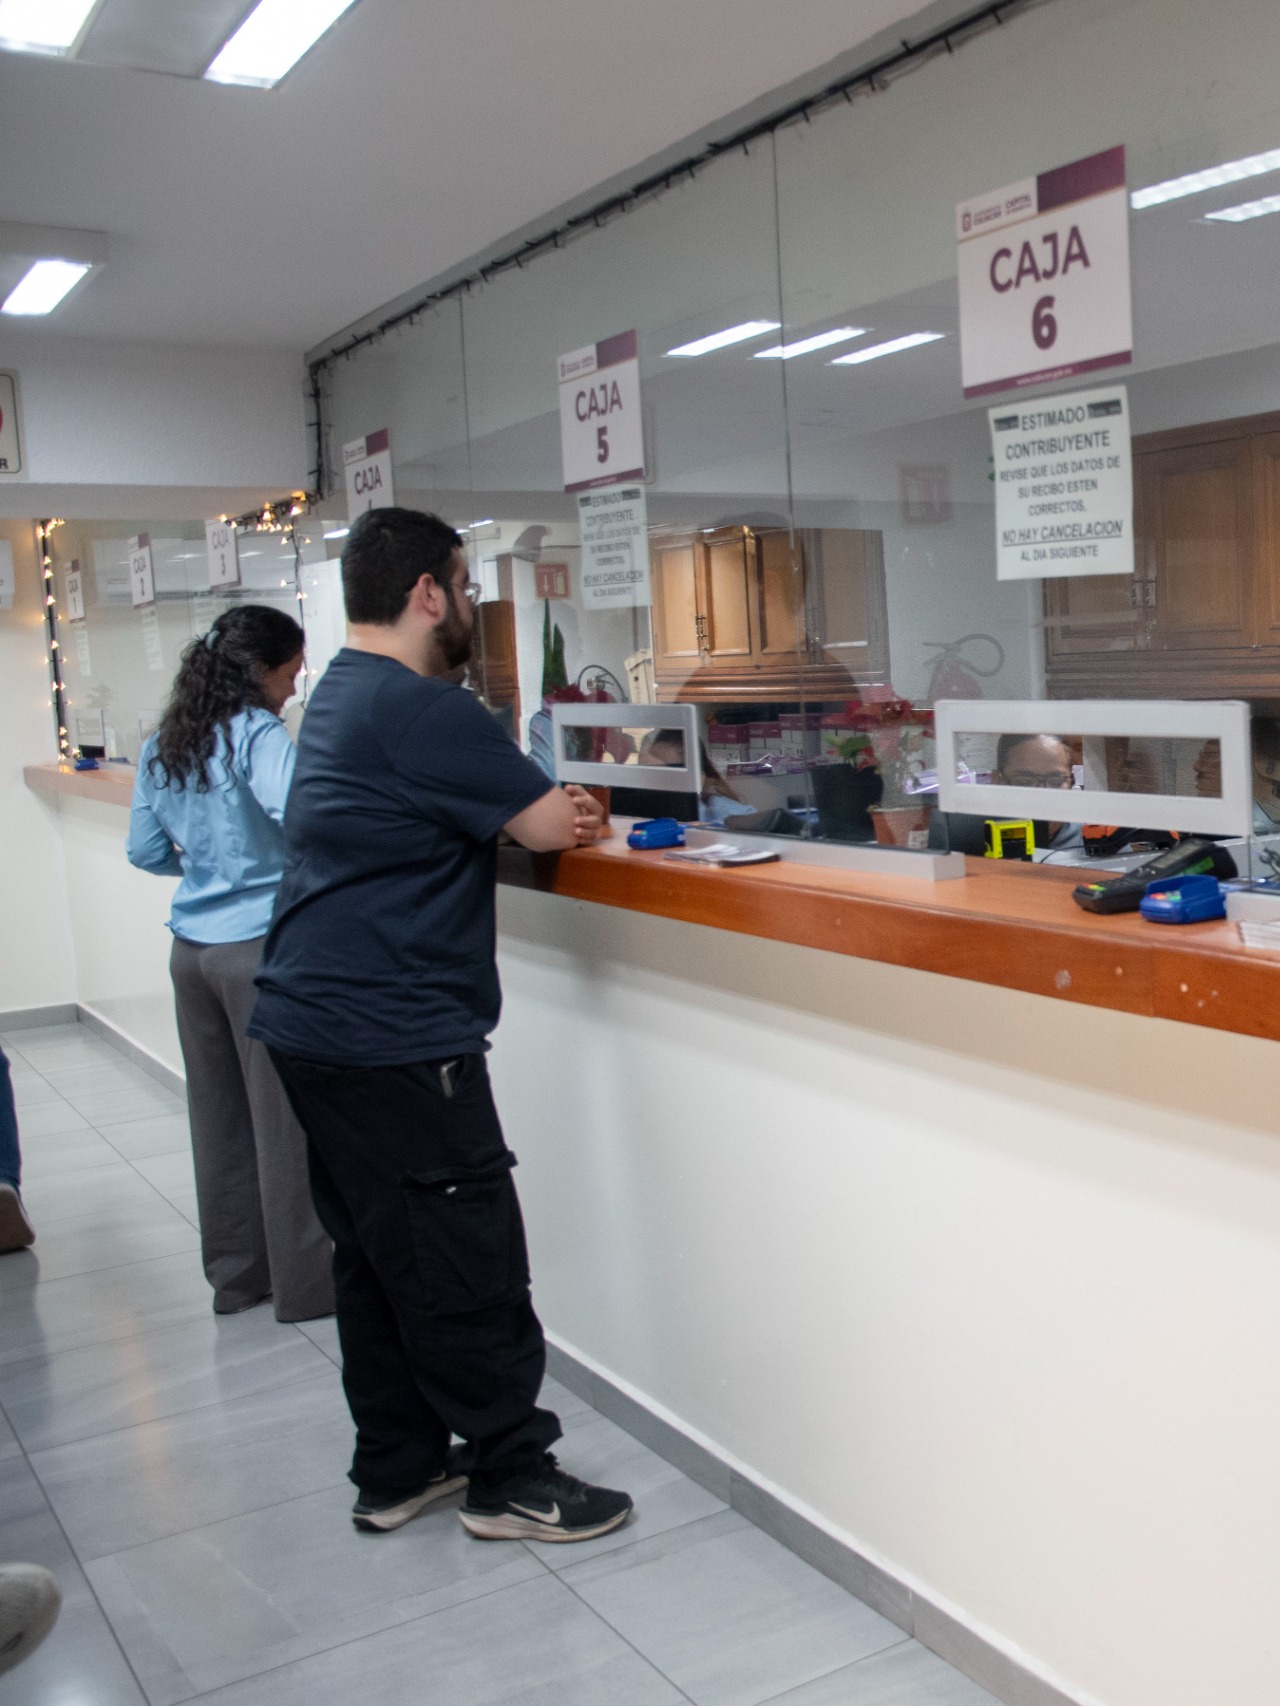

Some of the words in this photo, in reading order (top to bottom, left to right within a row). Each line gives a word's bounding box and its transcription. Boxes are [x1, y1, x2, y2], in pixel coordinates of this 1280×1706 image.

[990, 225, 1091, 294] CAJA
[1032, 295, 1058, 350] 6
[575, 380, 623, 422] CAJA
[1021, 406, 1086, 431] ESTIMADO
[597, 426, 610, 464] 5
[1005, 431, 1111, 461] CONTRIBUYENTE
[354, 464, 383, 496] CAJA
[1000, 467, 1029, 482] REVISE
[1030, 464, 1049, 478] QUE
[1050, 461, 1070, 475] LOS
[1071, 457, 1106, 473] DATOS
[1107, 455, 1121, 469] DE
[1018, 487, 1031, 499] SU
[1031, 482, 1066, 497] RECIBO
[1066, 479, 1099, 493] ESTEN
[1003, 530, 1018, 543] NO
[1019, 526, 1041, 541] HAY
[1041, 519, 1123, 540] CANCELACION
[1021, 550, 1031, 561] AL
[1032, 548, 1048, 560] DIA
[1049, 545, 1099, 559] SIGUIENTE
